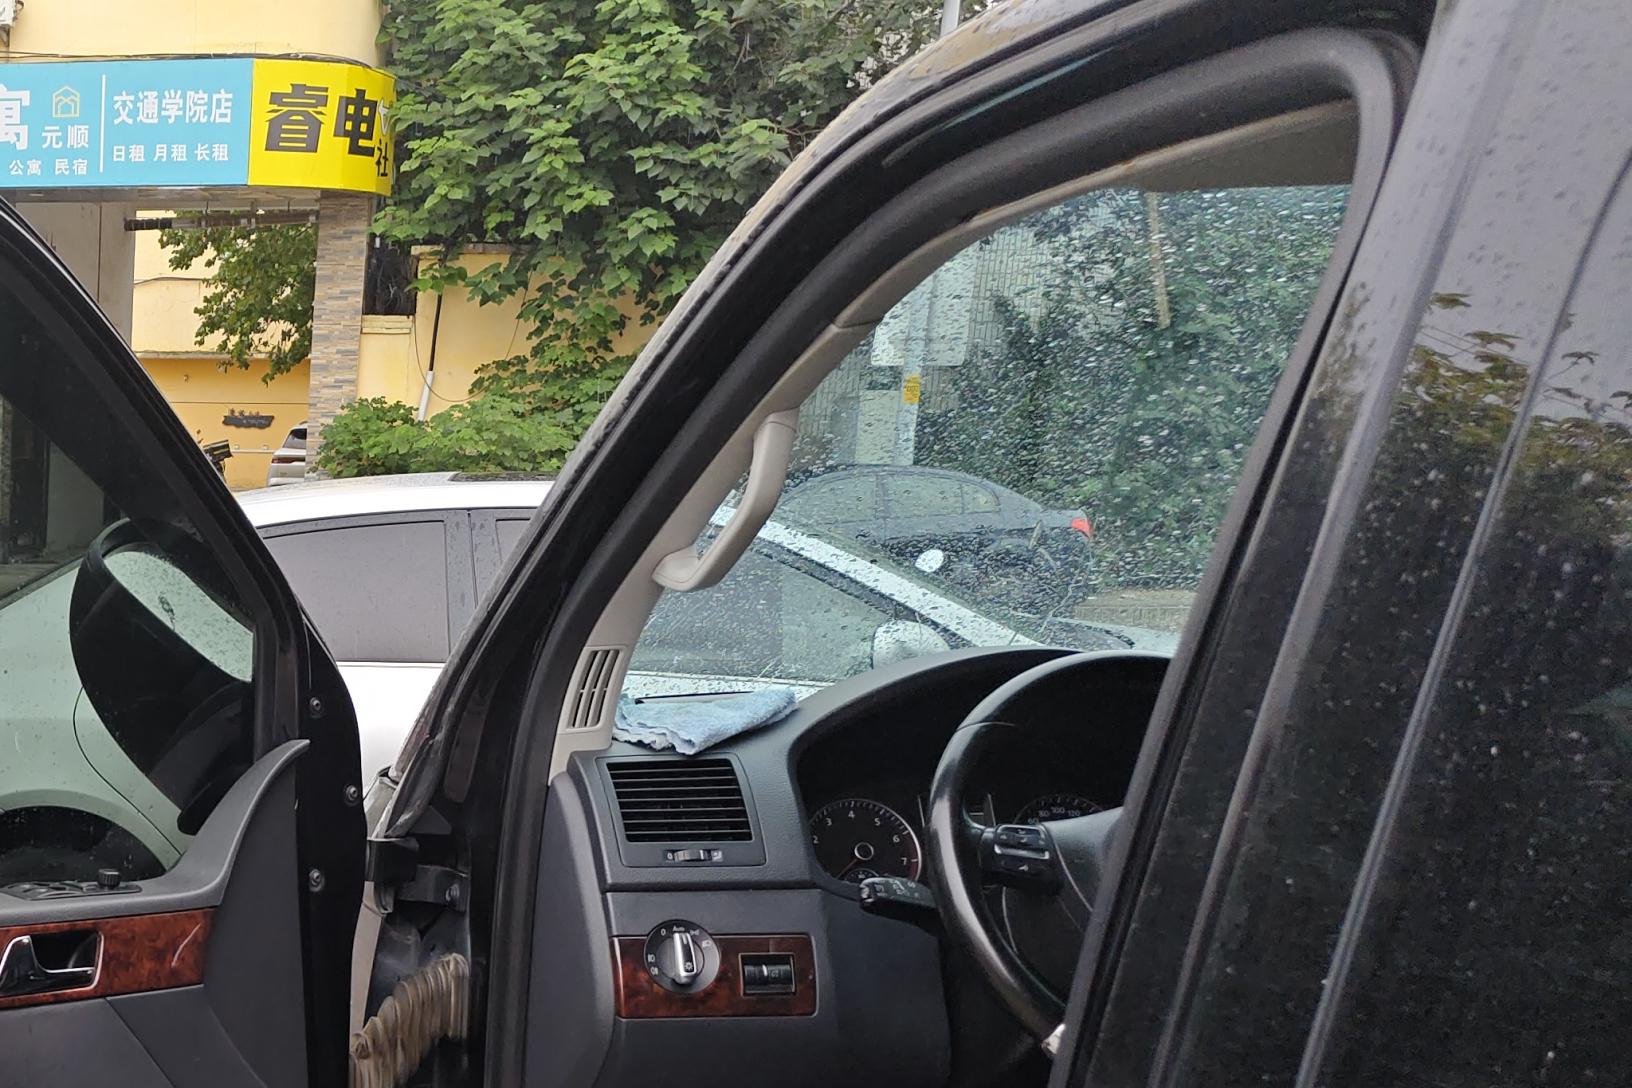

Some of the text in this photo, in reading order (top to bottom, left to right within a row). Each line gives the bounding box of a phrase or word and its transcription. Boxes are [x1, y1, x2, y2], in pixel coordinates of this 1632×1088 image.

[113, 89, 233, 125] 交通学院店
[41, 124, 89, 149] 元顺
[112, 143, 229, 162] 日租 月租 长租
[9, 158, 42, 176] 公寓
[54, 158, 88, 176] 民宿
[848, 810, 855, 818] 4
[826, 818, 832, 826] 3
[874, 818, 881, 826] 5
[893, 834, 900, 843] 6
